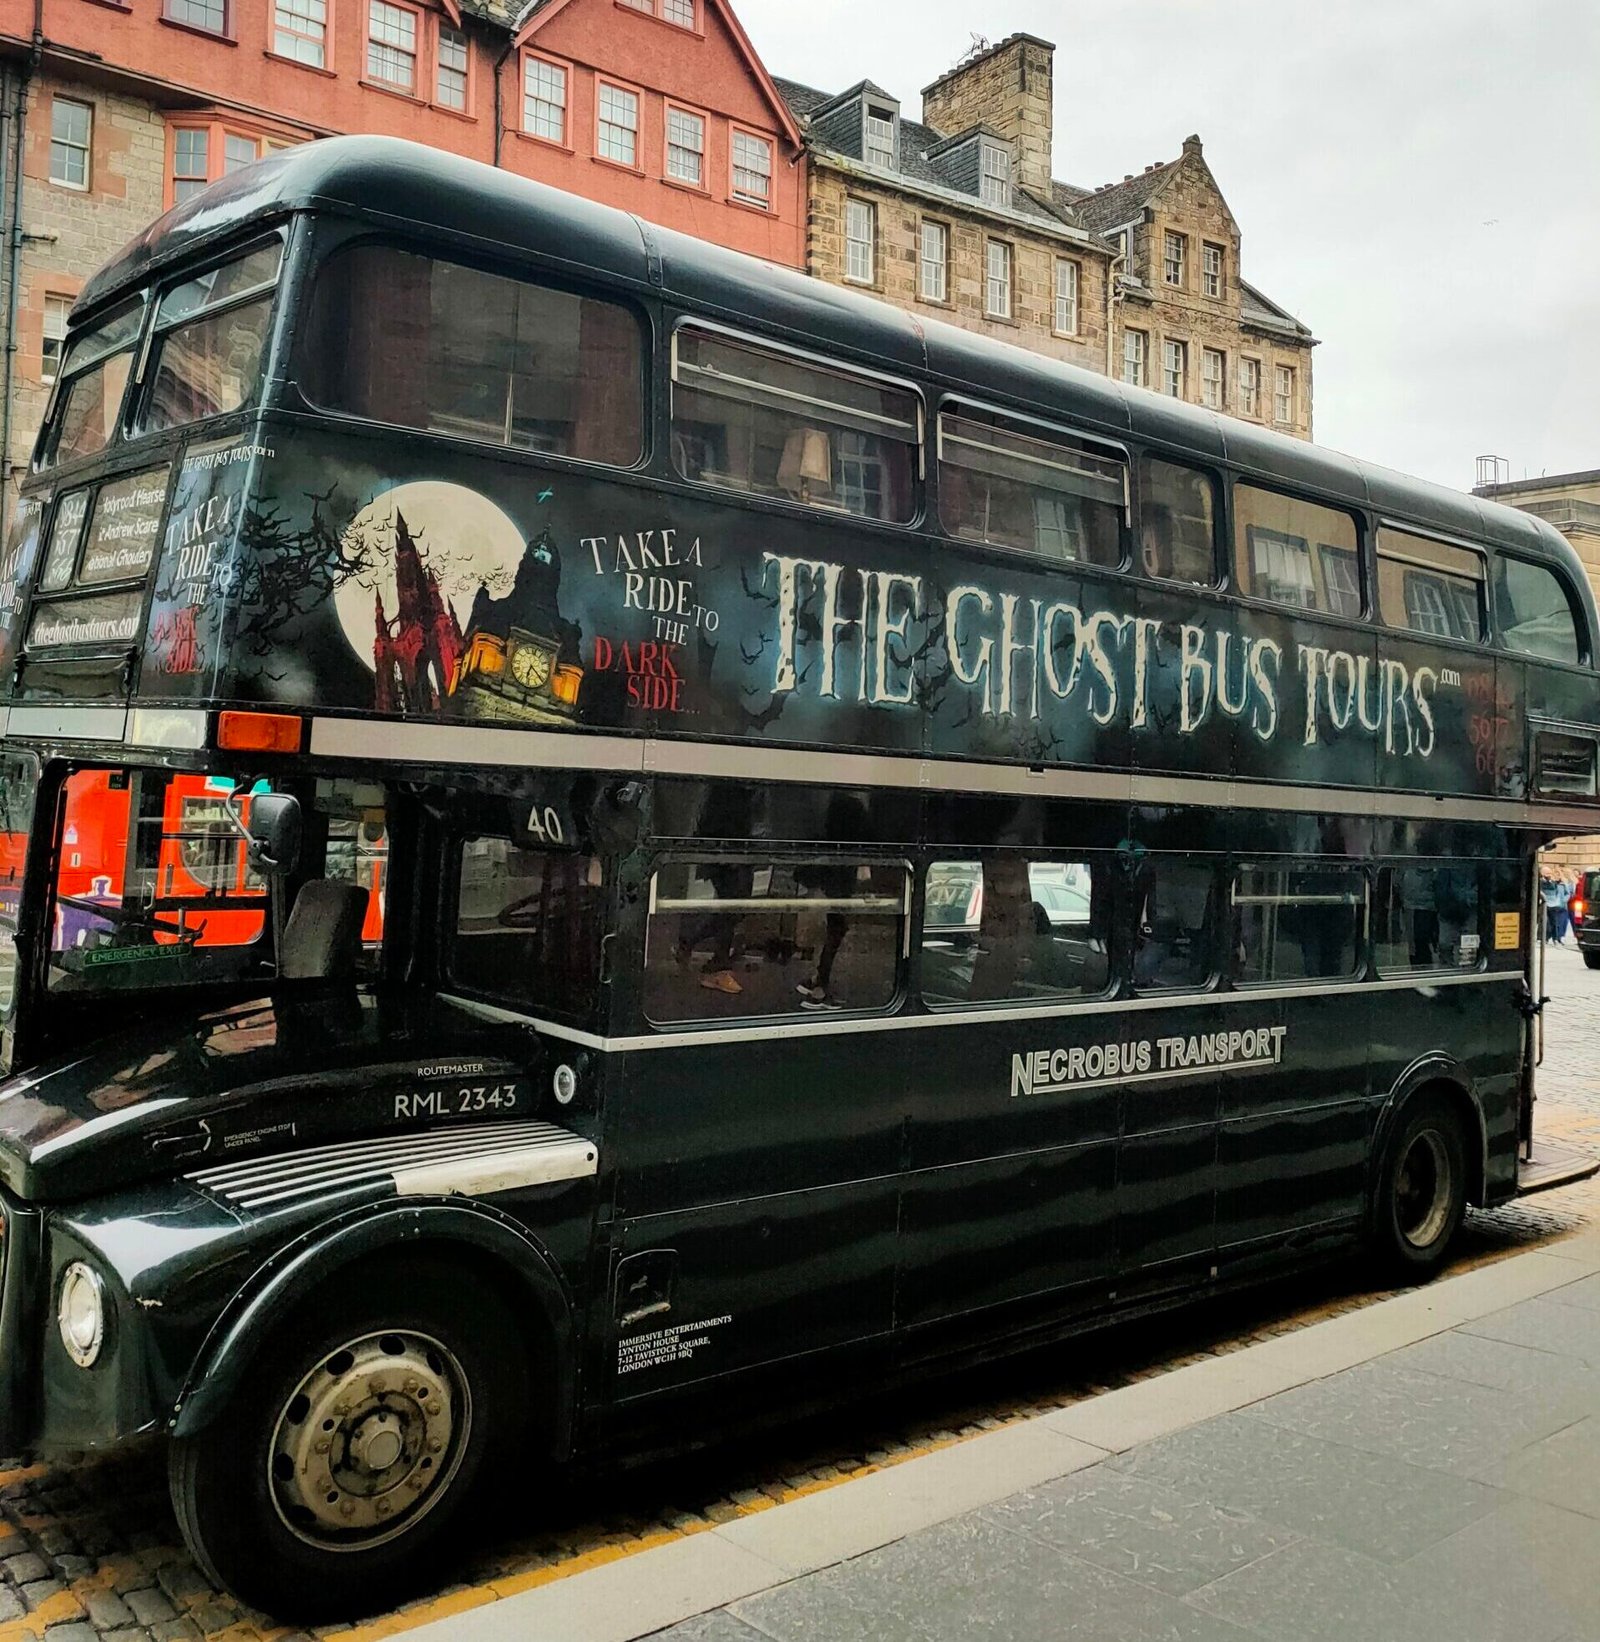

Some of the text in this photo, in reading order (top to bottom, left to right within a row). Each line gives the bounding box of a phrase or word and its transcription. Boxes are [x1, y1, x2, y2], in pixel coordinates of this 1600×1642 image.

[167, 495, 232, 556] TAKE A
[176, 541, 233, 586] RIDE TO
[580, 529, 703, 575] TAKE A
[187, 582, 208, 605] THE
[623, 572, 720, 632] RIDE TO
[652, 615, 689, 646] THE
[594, 636, 679, 679] DARK
[762, 551, 922, 706] THE
[946, 585, 1163, 730] GHOST
[1178, 624, 1283, 742] BUS
[1298, 643, 1439, 758] TOURS
[527, 805, 564, 844] 40
[91, 945, 183, 963] EMERGENCY EXIT
[417, 1063, 484, 1078] ROUTEMASTER
[1011, 1026, 1287, 1097] NECROBUS TRANSPORT
[394, 1084, 517, 1118] RML 2343
[618, 1314, 733, 1349] IMMERSIVE ENTERTAINMENTS
[618, 1335, 680, 1357] LYNTON HOUSE
[617, 1355, 633, 1366] 7-12
[634, 1344, 678, 1361] TAVISTOCK
[617, 1348, 693, 1375] LONDON WC1H 9BQ
